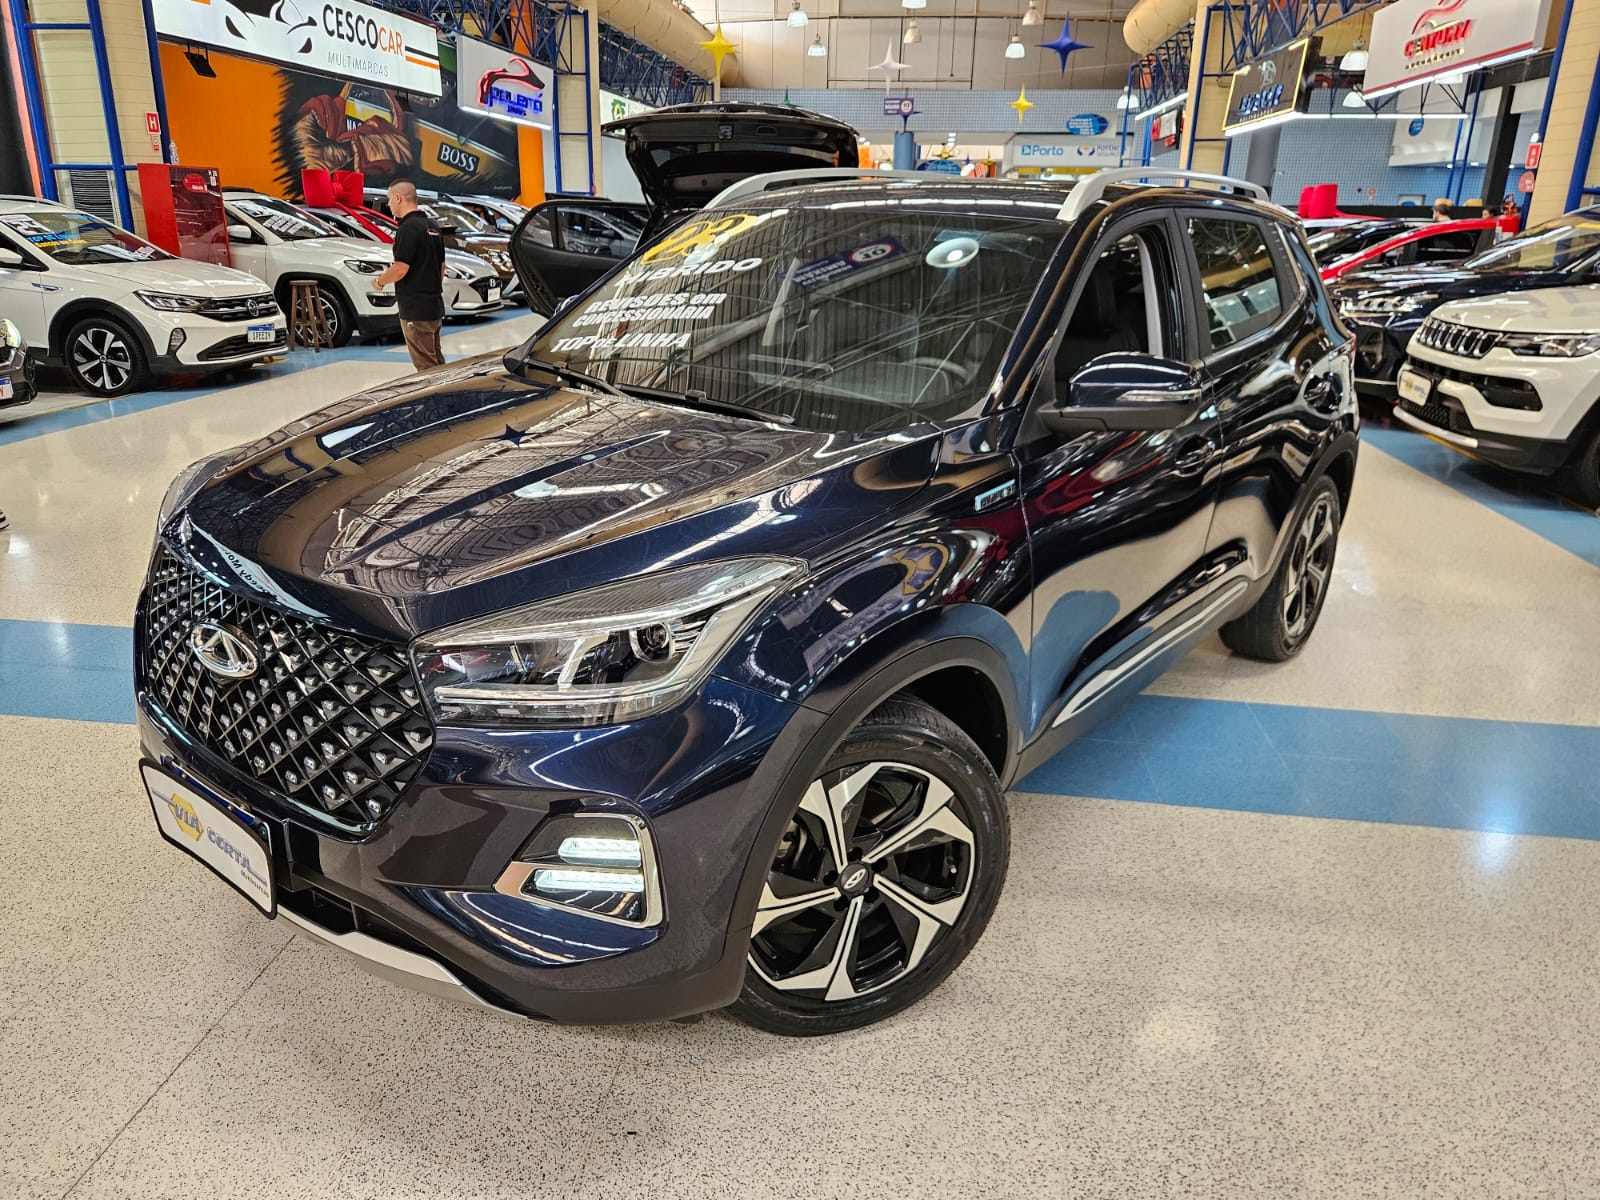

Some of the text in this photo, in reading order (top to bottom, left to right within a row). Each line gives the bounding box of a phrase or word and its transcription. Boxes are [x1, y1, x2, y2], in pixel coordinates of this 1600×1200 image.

[323, 4, 403, 57] CESCOCAR
[327, 51, 389, 78] MULTIMARCAS
[149, 115, 158, 131] H
[439, 143, 477, 173] BOSS
[1032, 145, 1064, 156] Porto
[550, 335, 597, 352] TOP
[615, 333, 691, 348] LINHA
[175, 804, 200, 833] VIA
[207, 827, 254, 871] CERTA
